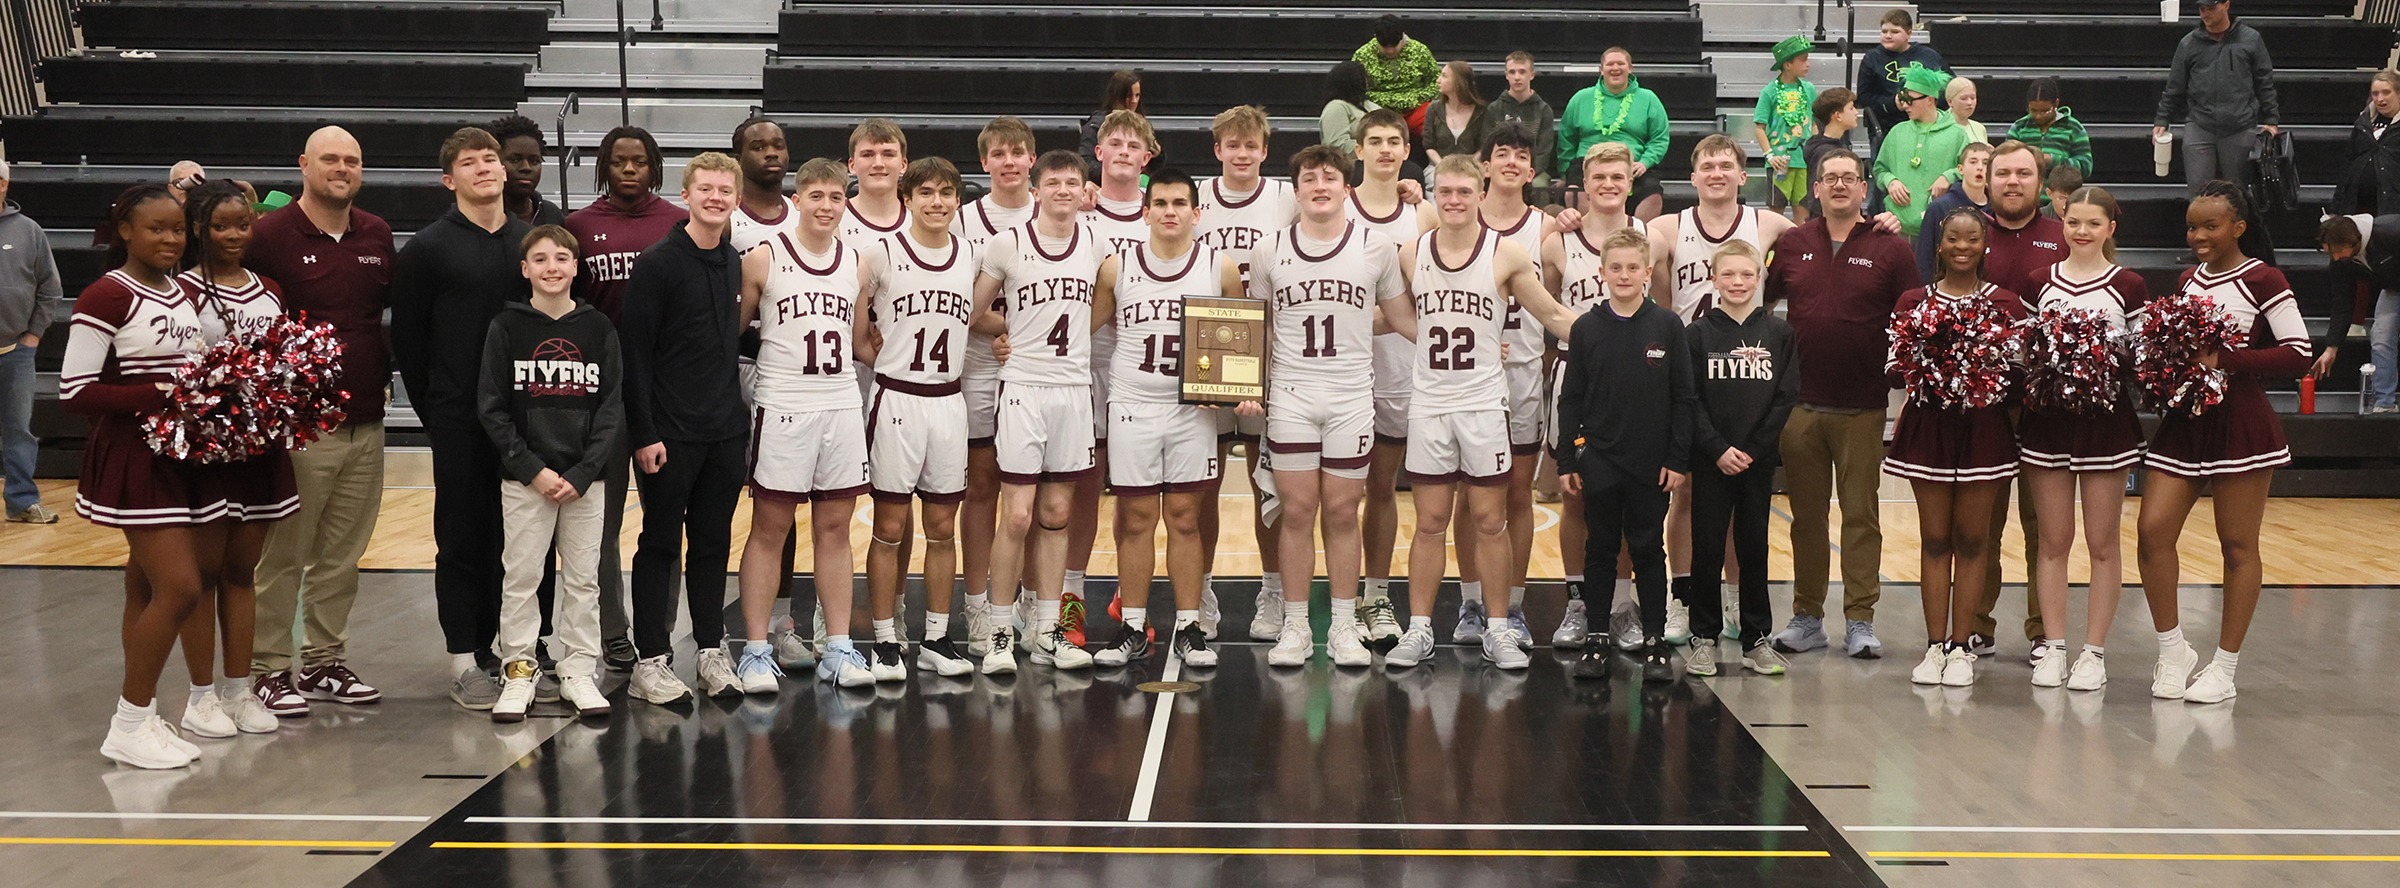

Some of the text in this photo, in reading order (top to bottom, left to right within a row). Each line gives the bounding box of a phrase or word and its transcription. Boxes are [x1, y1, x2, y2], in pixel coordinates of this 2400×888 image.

[2032, 240, 2058, 251] FLYERS
[585, 252, 641, 283] FREE
[1848, 256, 1873, 268] FLYERS
[893, 290, 970, 326] FLYERS
[1017, 278, 1094, 312] FLYERS
[1276, 280, 1367, 311] FLYERS
[1416, 289, 1494, 322] FLYERS
[1123, 299, 1181, 328] FLYE
[1208, 308, 1242, 318] STATE
[150, 314, 203, 350] Flyer
[1046, 313, 1070, 357] 4
[1302, 314, 1337, 358] 11
[803, 329, 842, 375] 13
[909, 328, 950, 373] 14
[1138, 334, 1180, 378] 15
[1428, 325, 1476, 371] 22
[1707, 358, 1773, 381] FLYERS
[1191, 384, 1255, 395] QUALIFIER
[1357, 435, 1369, 454] F
[1206, 458, 1217, 476] F
[1495, 452, 1506, 471] F
